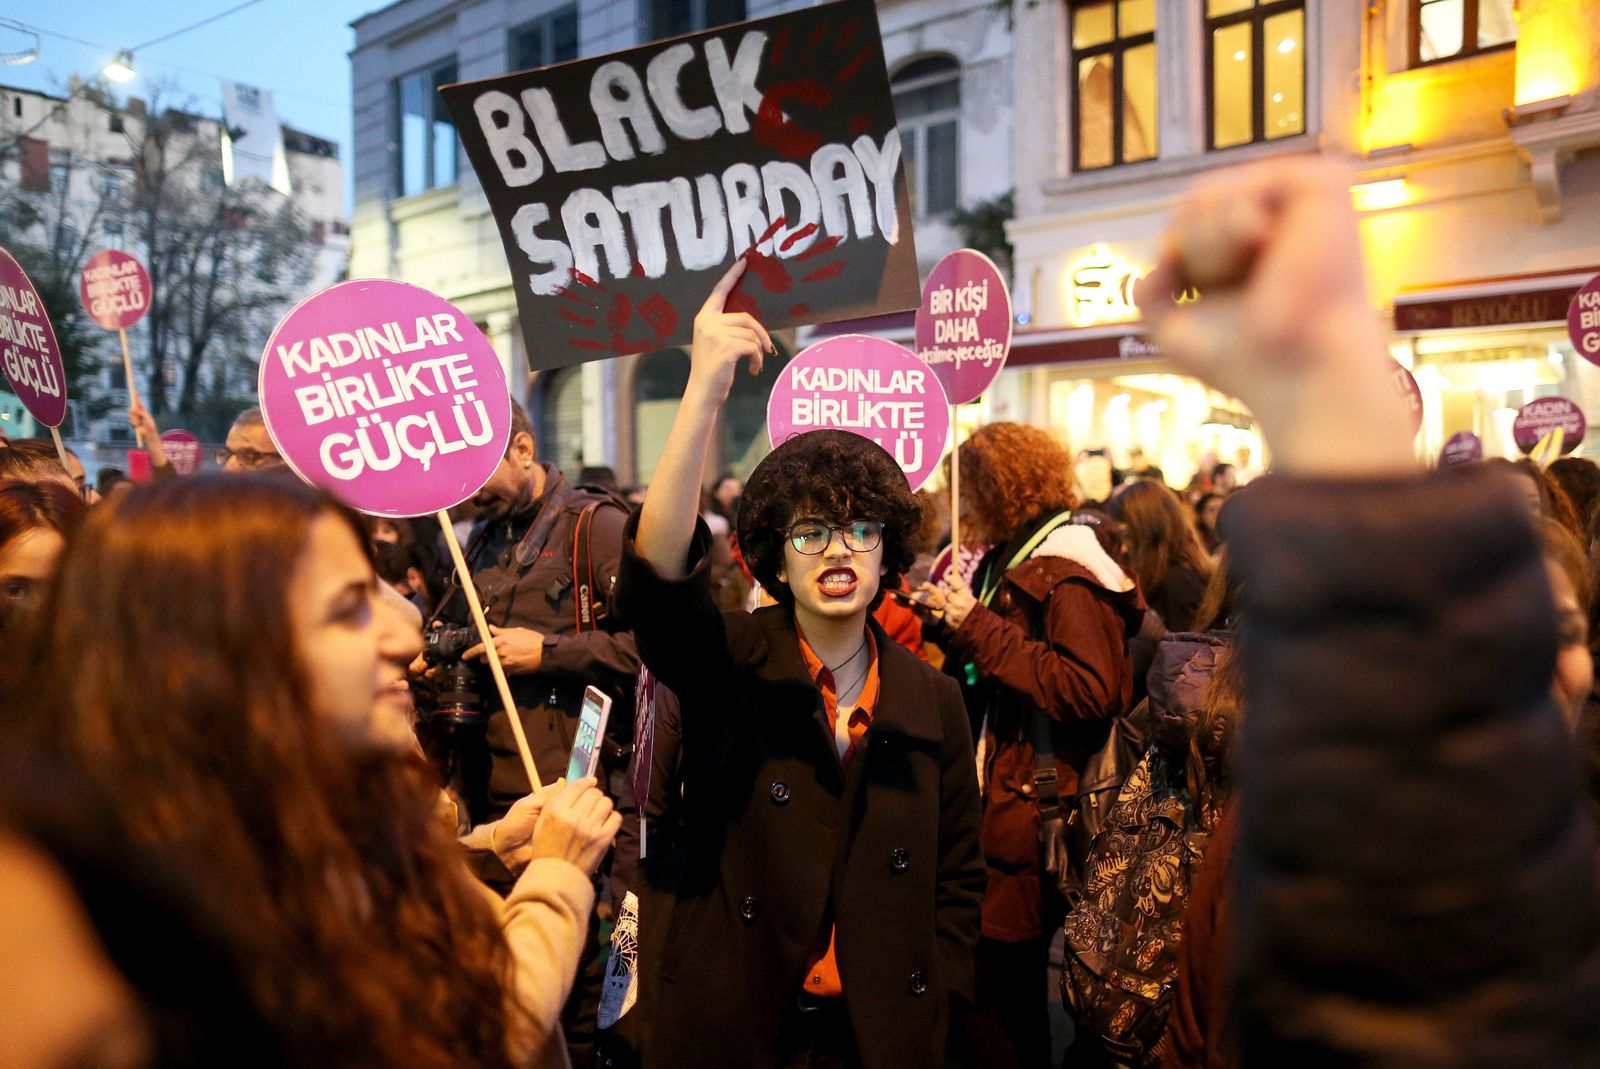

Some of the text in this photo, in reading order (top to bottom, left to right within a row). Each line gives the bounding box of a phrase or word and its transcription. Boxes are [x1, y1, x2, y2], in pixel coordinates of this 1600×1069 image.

[473, 30, 790, 188] BLACK
[511, 127, 902, 295] SATURDAY
[930, 279, 988, 317] BİR KİŞİ
[277, 313, 463, 378] KADINLAR
[934, 317, 979, 343] DAHA
[4, 345, 60, 398] GÜÇLÜ
[294, 353, 479, 426] BİRLİKTE
[791, 366, 926, 394] KADINLAR
[319, 391, 494, 480] GÜÇLÜ
[791, 392, 925, 429] BİRLİKTE
[579, 584, 590, 623] Canon
